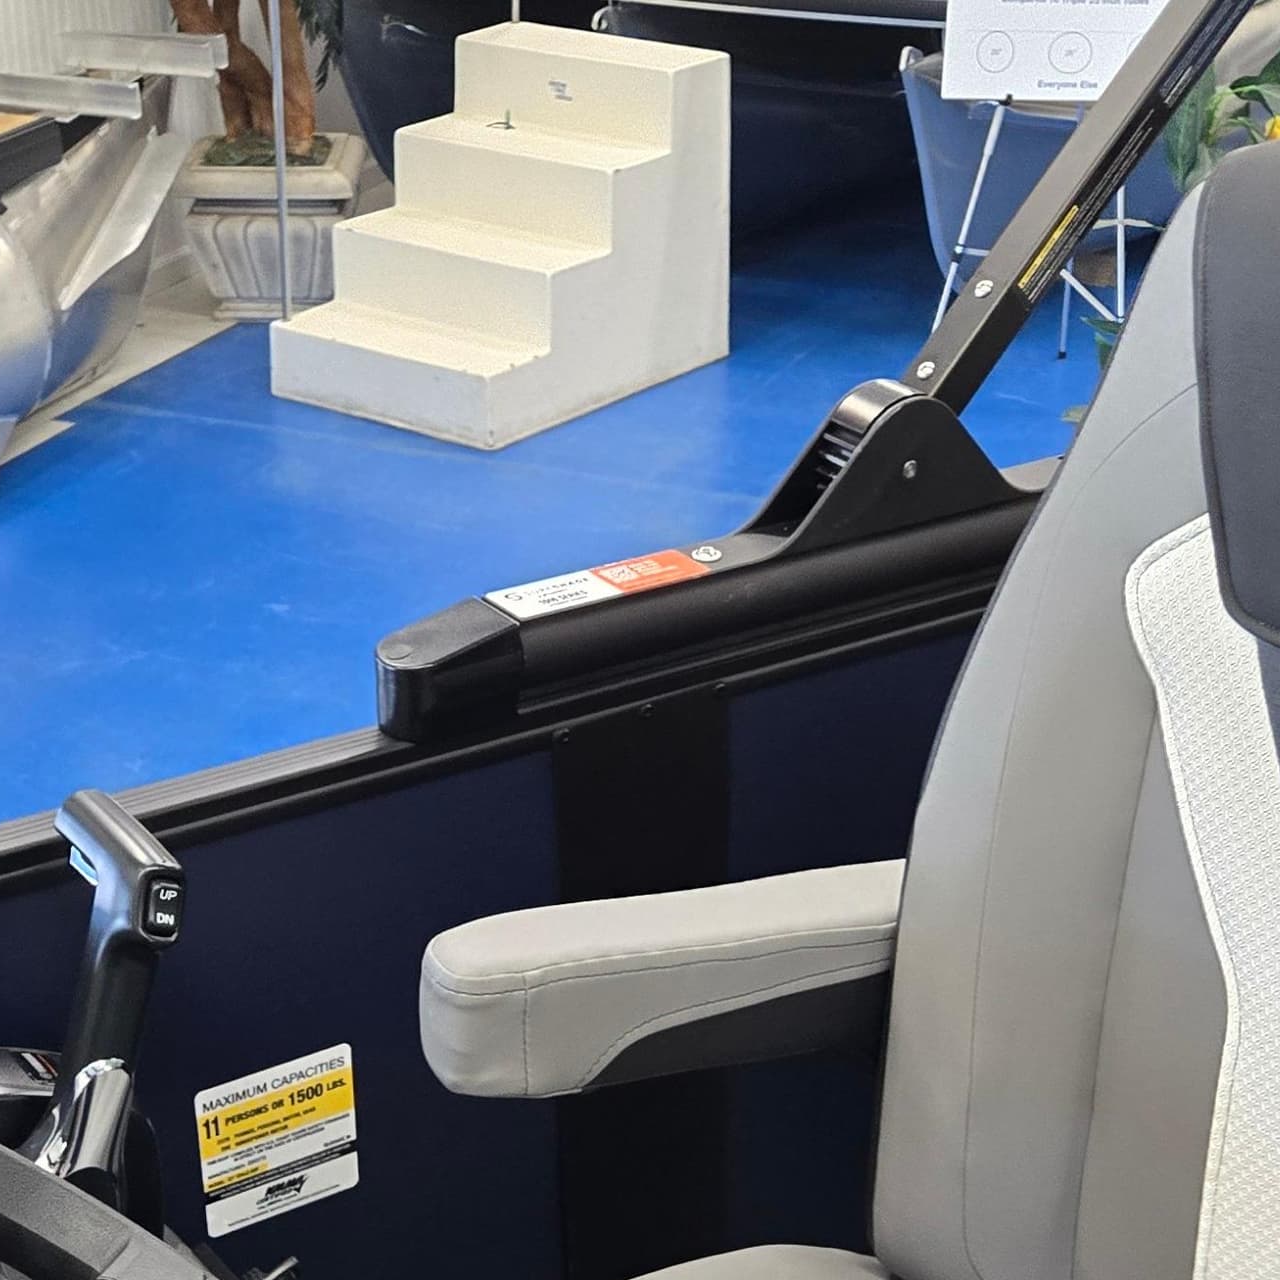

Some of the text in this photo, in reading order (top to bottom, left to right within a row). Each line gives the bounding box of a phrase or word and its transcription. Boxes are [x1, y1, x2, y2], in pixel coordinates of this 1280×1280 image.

[159, 888, 178, 901] UP
[156, 911, 175, 926] DN
[202, 1056, 346, 1113] MAXIMUM CAPACITIES
[202, 1114, 220, 1140] 11
[225, 1103, 270, 1126] PERSONS
[271, 1099, 285, 1111] OR
[288, 1083, 324, 1107] 1500
[326, 1077, 348, 1092] LBS.
